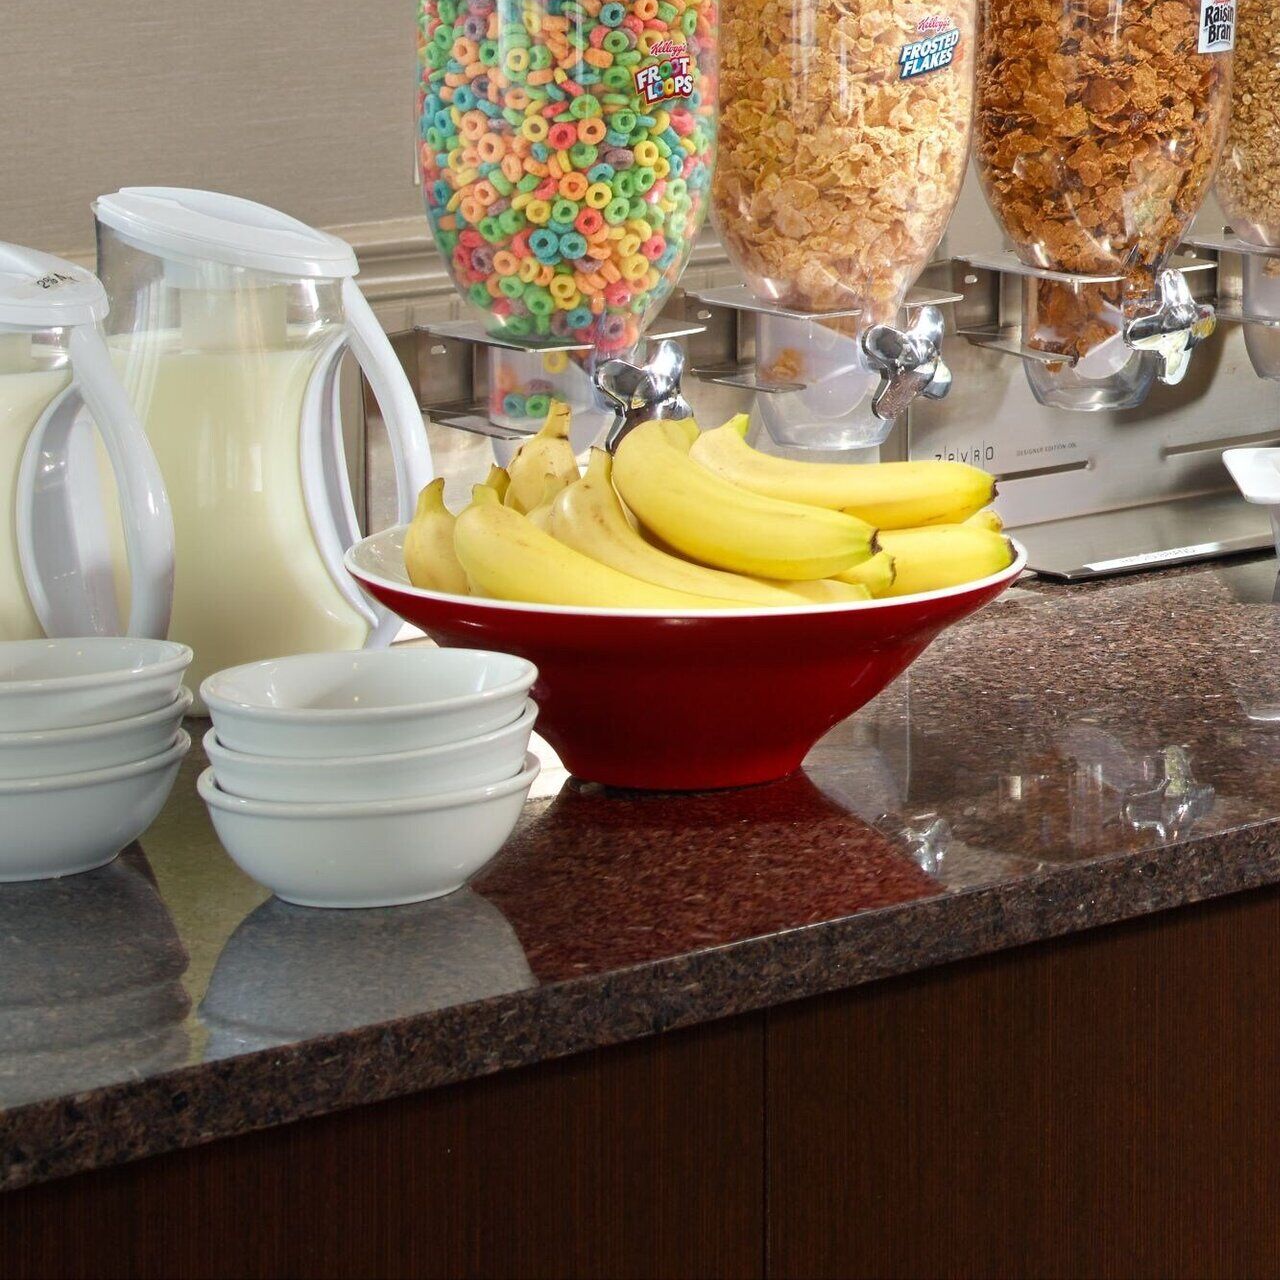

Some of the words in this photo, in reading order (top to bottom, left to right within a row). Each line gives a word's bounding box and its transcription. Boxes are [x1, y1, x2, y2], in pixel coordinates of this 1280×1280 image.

[1204, 4, 1234, 27] Raisin
[900, 29, 960, 63] FROSTED
[1208, 23, 1232, 44] Bran
[636, 56, 690, 91] FROOT
[901, 46, 954, 77] FLAKES
[646, 75, 694, 101] LOOPS
